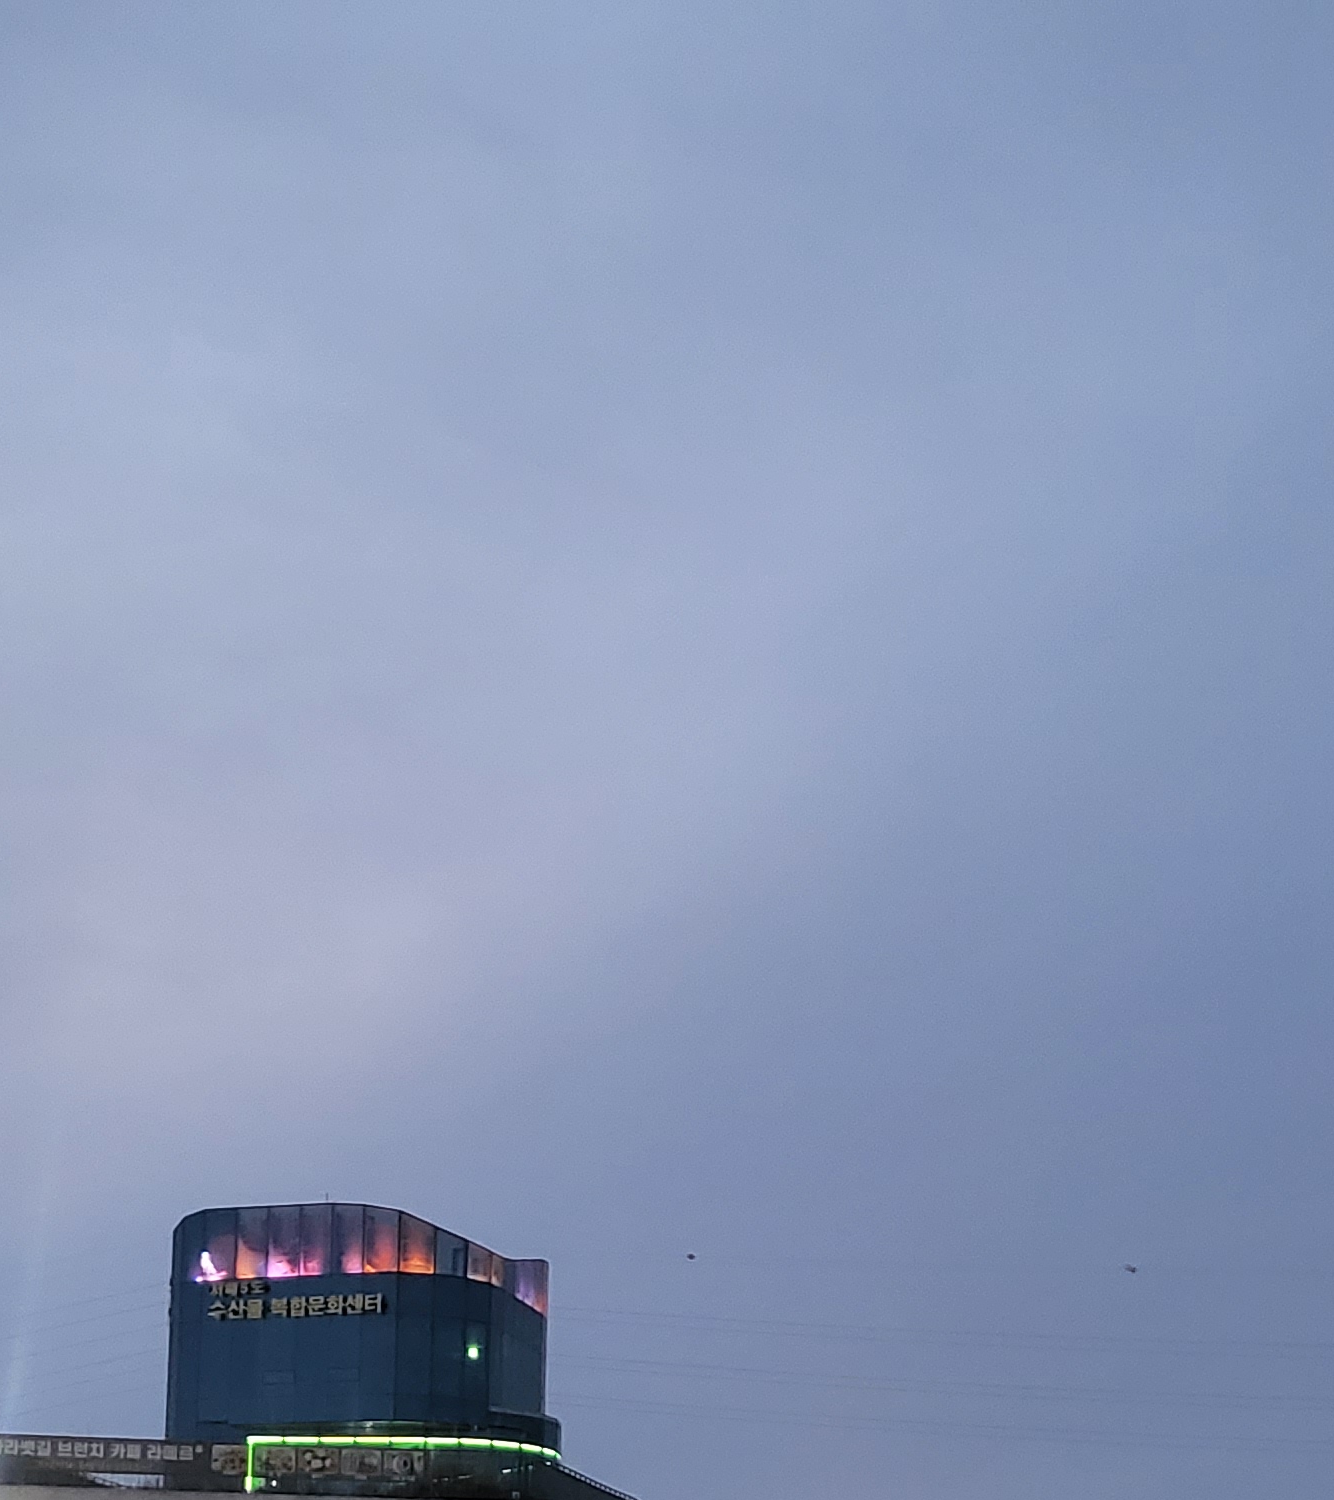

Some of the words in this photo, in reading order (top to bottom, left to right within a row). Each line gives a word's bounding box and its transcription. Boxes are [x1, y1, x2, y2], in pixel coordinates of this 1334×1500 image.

[207, 1298, 262, 1320] 수산물
[271, 1293, 383, 1318] 복합문화센터
[57, 1442, 104, 1458] 브런치
